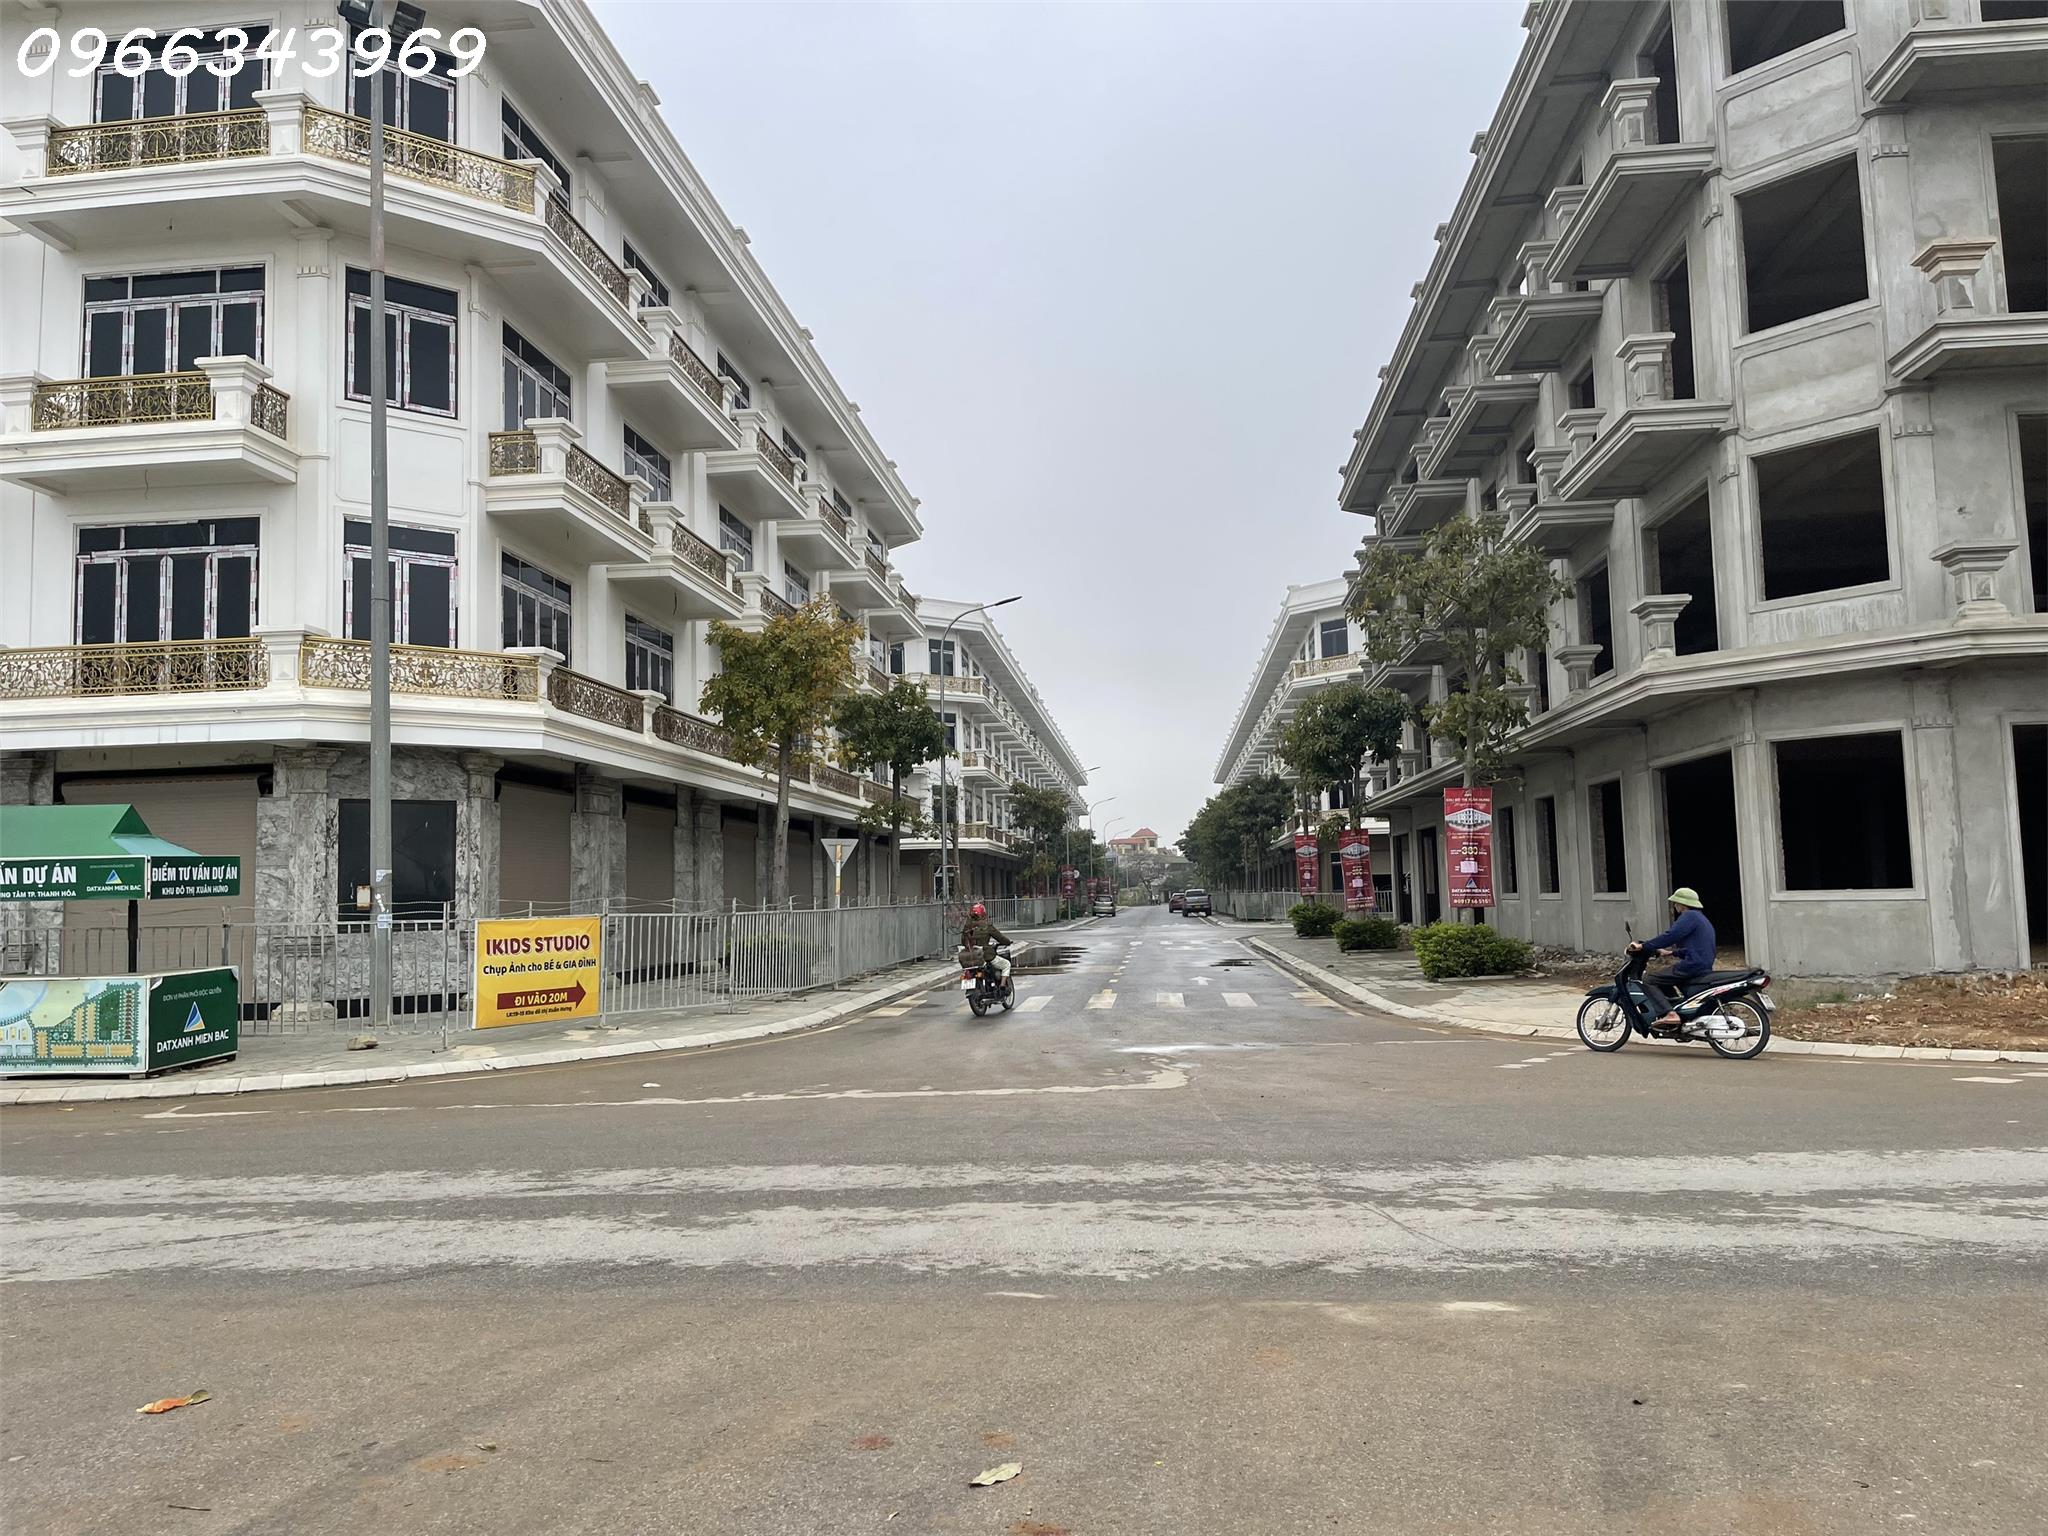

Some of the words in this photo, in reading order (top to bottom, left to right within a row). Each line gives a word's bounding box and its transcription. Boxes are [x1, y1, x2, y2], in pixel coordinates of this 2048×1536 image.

[22, 865, 49, 888] DỰ
[51, 862, 77, 884] ÁN
[152, 861, 177, 882] ĐIỂM
[192, 861, 211, 881] VẤN
[212, 866, 225, 882] DỰ
[225, 863, 238, 880] ÁN
[37, 890, 60, 898] THANH
[486, 937, 532, 956] IKIDS
[534, 934, 590, 953] STUDIO
[483, 964, 508, 976] Chụp
[527, 962, 543, 972] cho
[555, 960, 562, 969] &
[563, 960, 578, 969] GIA
[514, 995, 526, 1007] ĐI
[527, 991, 548, 1005] VÀO
[548, 992, 568, 1003] 20M
[156, 1036, 194, 1053] DATXANH
[194, 1031, 214, 1045] MIEN
[214, 1028, 230, 1041] BAC
